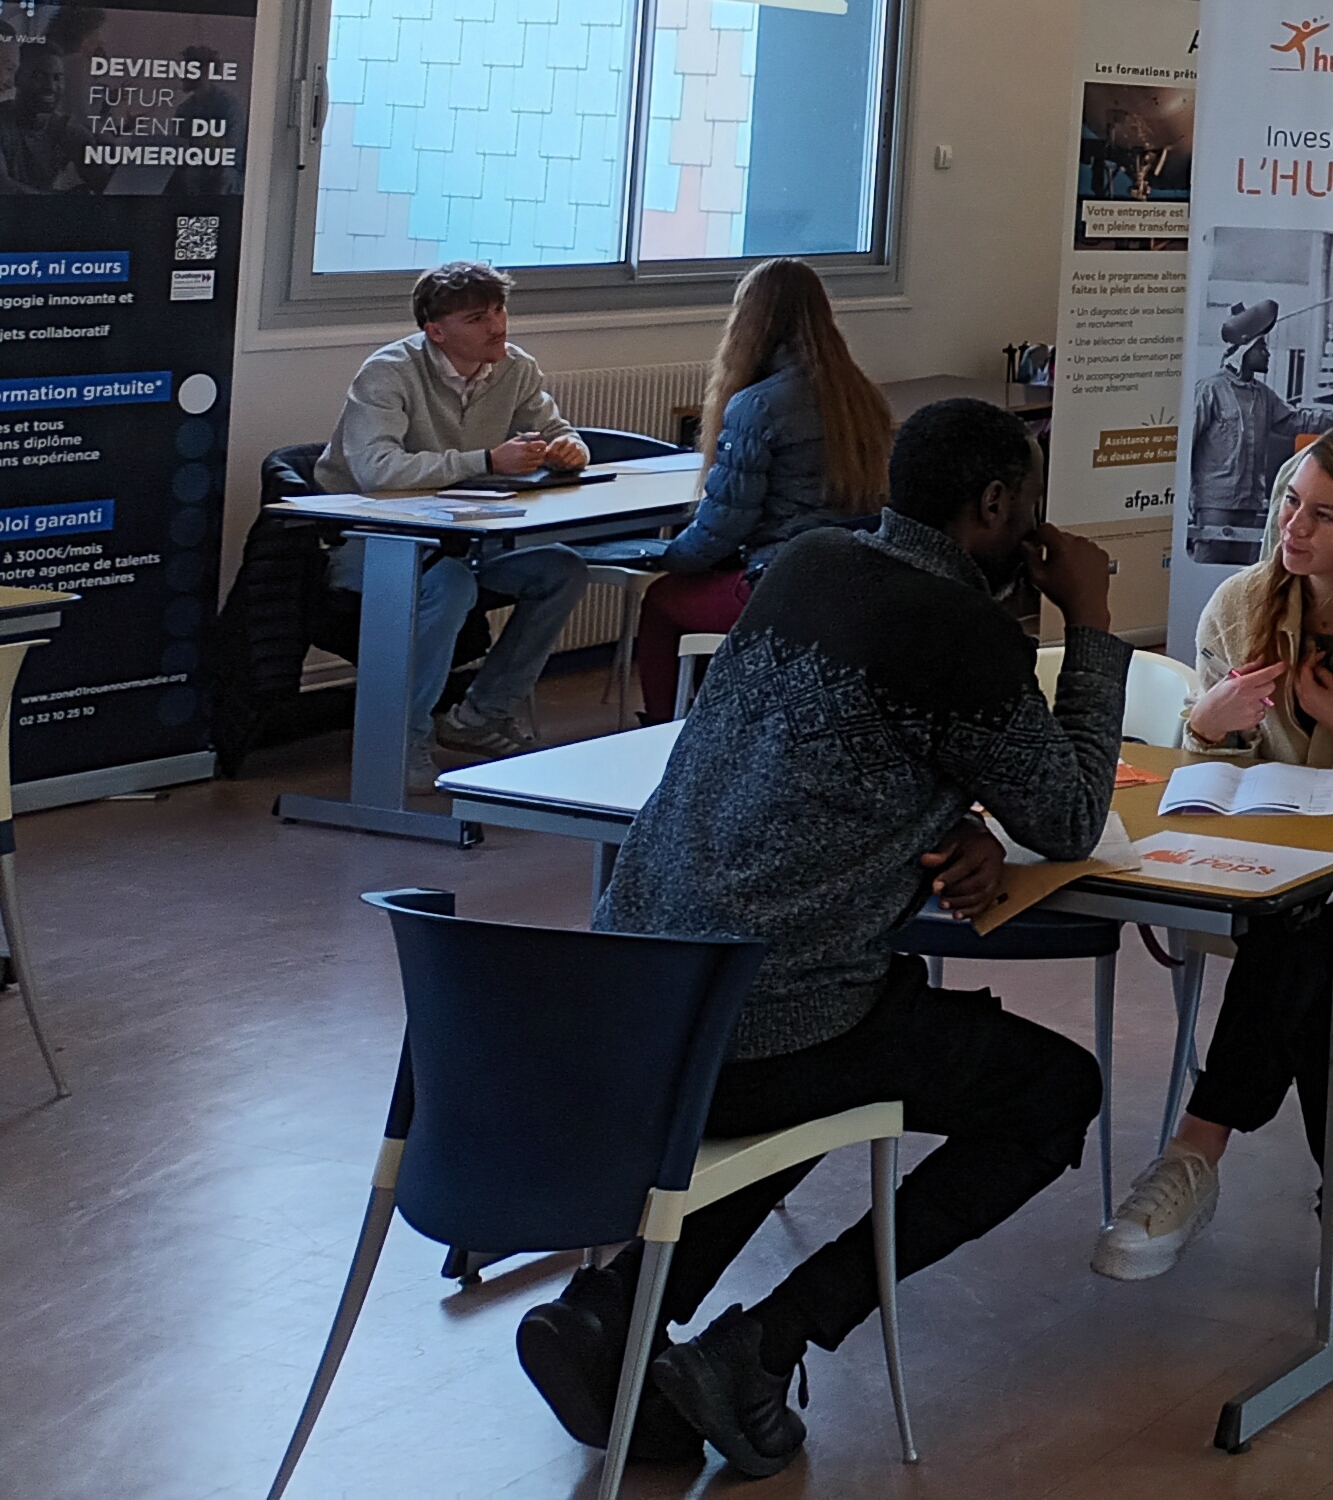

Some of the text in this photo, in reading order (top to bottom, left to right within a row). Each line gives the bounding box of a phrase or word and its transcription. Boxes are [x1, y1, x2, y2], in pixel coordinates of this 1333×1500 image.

[90, 56, 237, 81] DEVIENS LE
[1095, 62, 1113, 74] Les
[1116, 63, 1171, 78] formations
[89, 86, 174, 107] FUTUR
[87, 115, 227, 137] TALENT DU
[84, 145, 236, 166] NUMERIQUE
[1086, 205, 1184, 222] Votre entreprise est
[1092, 222, 1104, 231] en
[1107, 221, 1136, 237] pleine
[49, 260, 65, 275] ni
[71, 261, 122, 275] cours
[1072, 271, 1096, 281] Avec
[1098, 270, 1106, 281] le
[1108, 272, 1160, 283] programme
[1071, 284, 1097, 294] faites
[1100, 284, 1108, 294] le
[1109, 284, 1131, 296] plein
[1133, 284, 1145, 294] de
[1147, 284, 1169, 294] bons
[48, 293, 116, 306] innovante
[118, 292, 134, 303] et
[1077, 307, 1089, 316] Un
[1090, 306, 1128, 318] diagnostic
[1130, 306, 1140, 315] de
[29, 325, 110, 339] collaboratif
[1088, 320, 1133, 328] recrutement
[1075, 337, 1091, 346] Une
[1127, 335, 1138, 345] de
[1074, 355, 1086, 364] Un
[1121, 353, 1131, 362] de
[1132, 352, 1168, 361] formation
[1073, 372, 1085, 381] Un
[0, 384, 77, 402] rmation
[1072, 385, 1083, 394] de
[14, 421, 29, 433] et
[33, 420, 64, 432] tous
[24, 434, 82, 450] diplôme
[1105, 435, 1149, 446] Assistance
[22, 450, 100, 466] expérience
[1096, 454, 1107, 463] du
[1110, 451, 1141, 462] dossier
[1143, 450, 1154, 459] de
[35, 508, 102, 532] garanti
[3, 543, 103, 564] à 3000€/mois
[39, 563, 91, 578] agence
[94, 558, 112, 571] de
[115, 553, 161, 569] talents
[58, 572, 135, 592] partenaires
[19, 714, 34, 726] 02
[36, 713, 50, 724] 32
[52, 710, 65, 721] 10
[83, 706, 95, 716] 10
